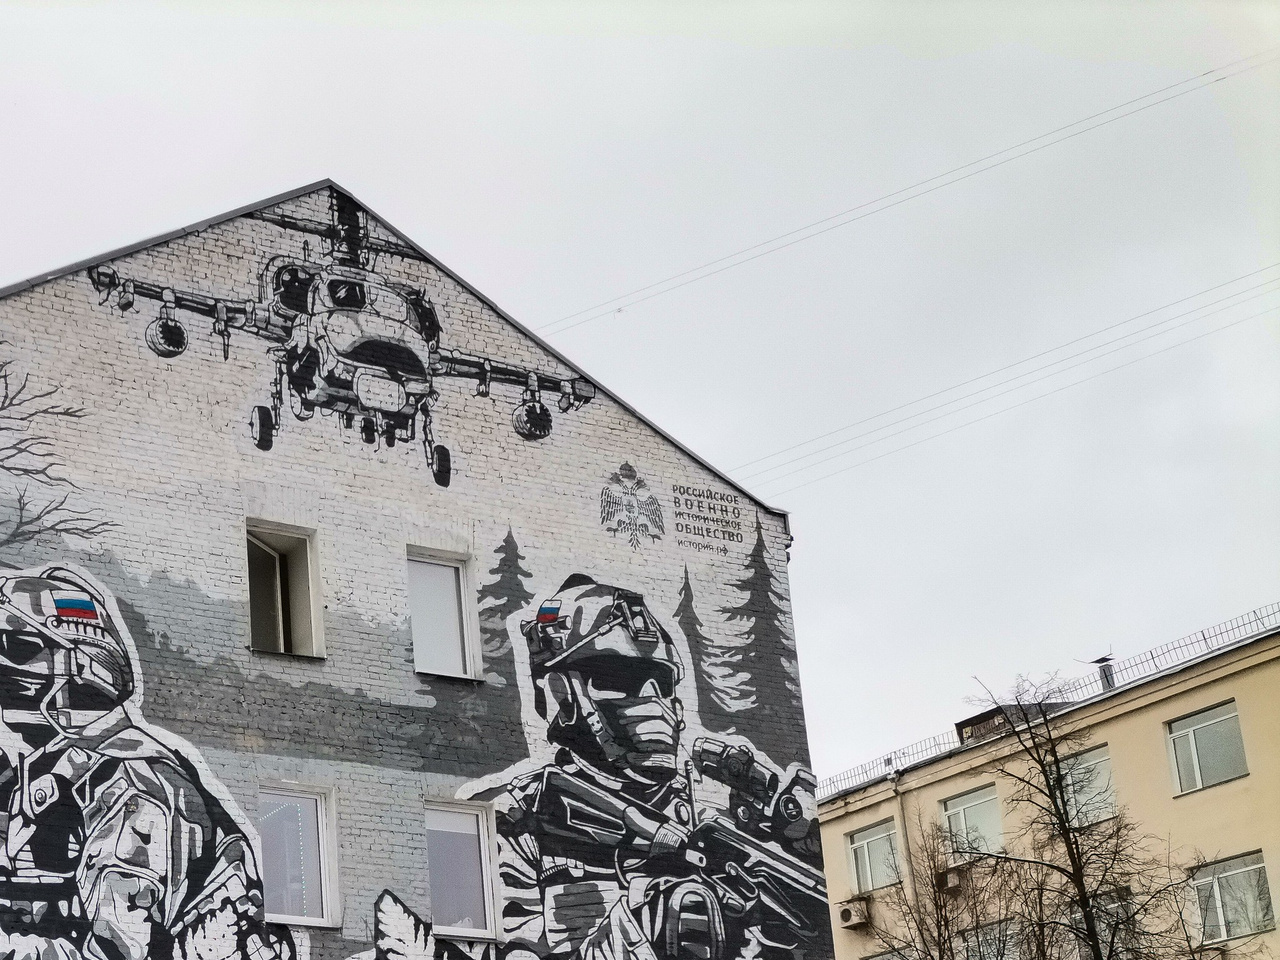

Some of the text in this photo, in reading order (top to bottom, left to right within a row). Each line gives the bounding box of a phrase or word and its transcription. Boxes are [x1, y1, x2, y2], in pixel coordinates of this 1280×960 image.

[672, 484, 739, 505] РОССИЙСКОЕ
[673, 496, 741, 519] ВОЕННО
[674, 510, 742, 531] ИСТОРИЧЕСКОЕ
[675, 522, 743, 543] ОБЩЕСТВО
